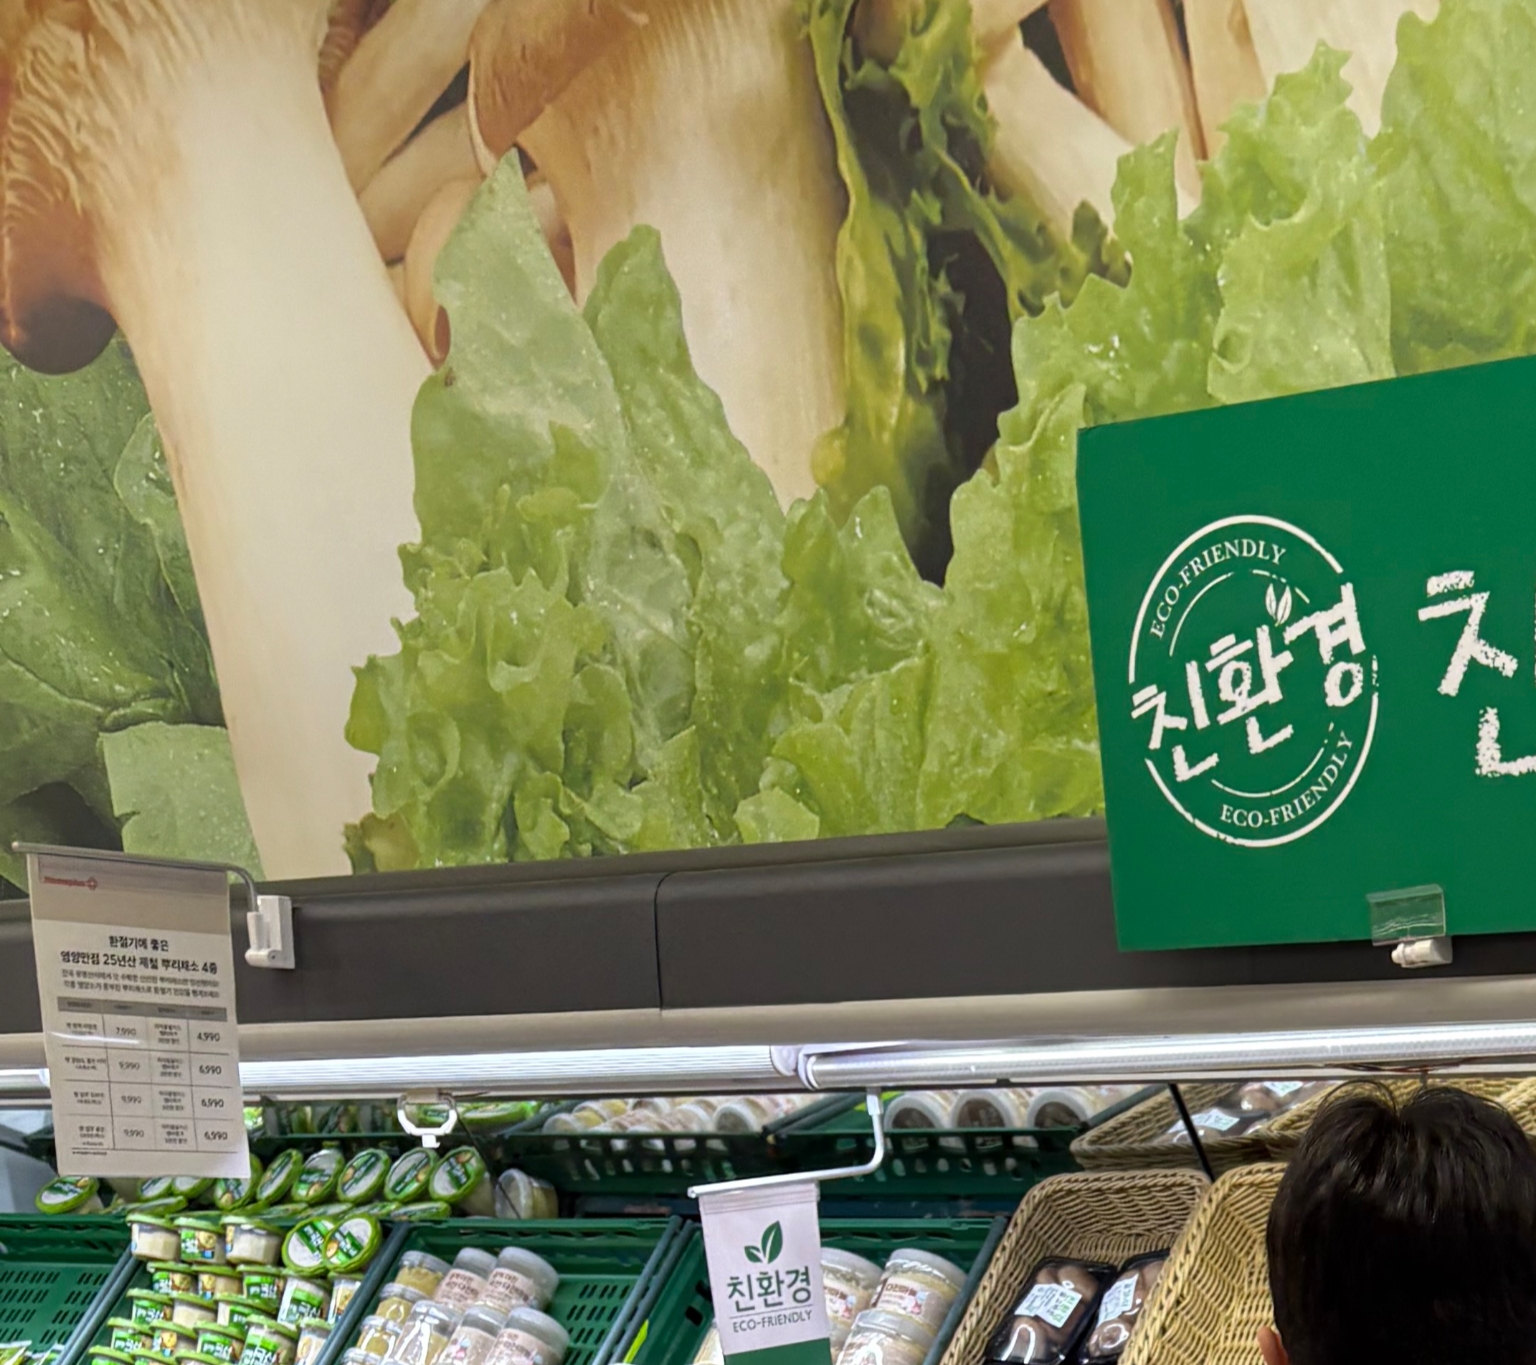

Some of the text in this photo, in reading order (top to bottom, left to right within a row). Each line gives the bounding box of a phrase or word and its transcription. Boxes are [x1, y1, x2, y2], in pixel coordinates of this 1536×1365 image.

[1149, 537, 1287, 640] ECO-FRIENDLY
[1130, 581, 1368, 784] 친환경
[1219, 731, 1353, 828] ECO-FRIENDLY
[102, 953, 138, 968] 25년산
[197, 1032, 221, 1042] 4,990
[199, 1065, 222, 1075] 6,990
[201, 1098, 224, 1108] 6,990
[204, 1131, 228, 1141] 6,990
[726, 1265, 812, 1313] 친환경
[732, 1308, 813, 1334] ECO-FRIENDLY
